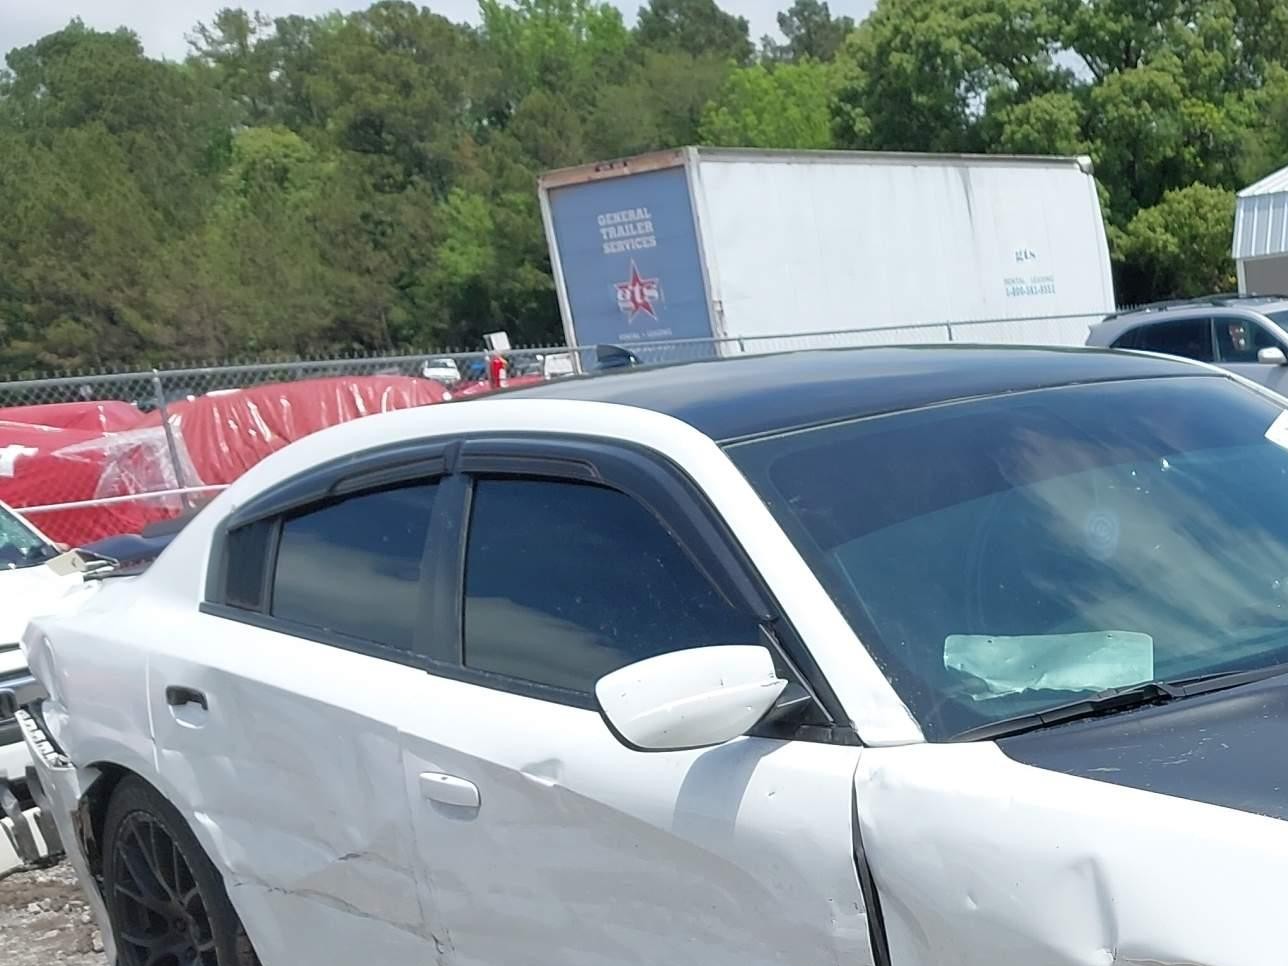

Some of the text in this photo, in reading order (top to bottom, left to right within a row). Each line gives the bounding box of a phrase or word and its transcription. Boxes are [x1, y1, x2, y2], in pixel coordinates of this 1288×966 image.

[597, 207, 652, 226] GENERAL
[600, 220, 654, 239] TRAILER
[602, 235, 656, 254] SERVICES
